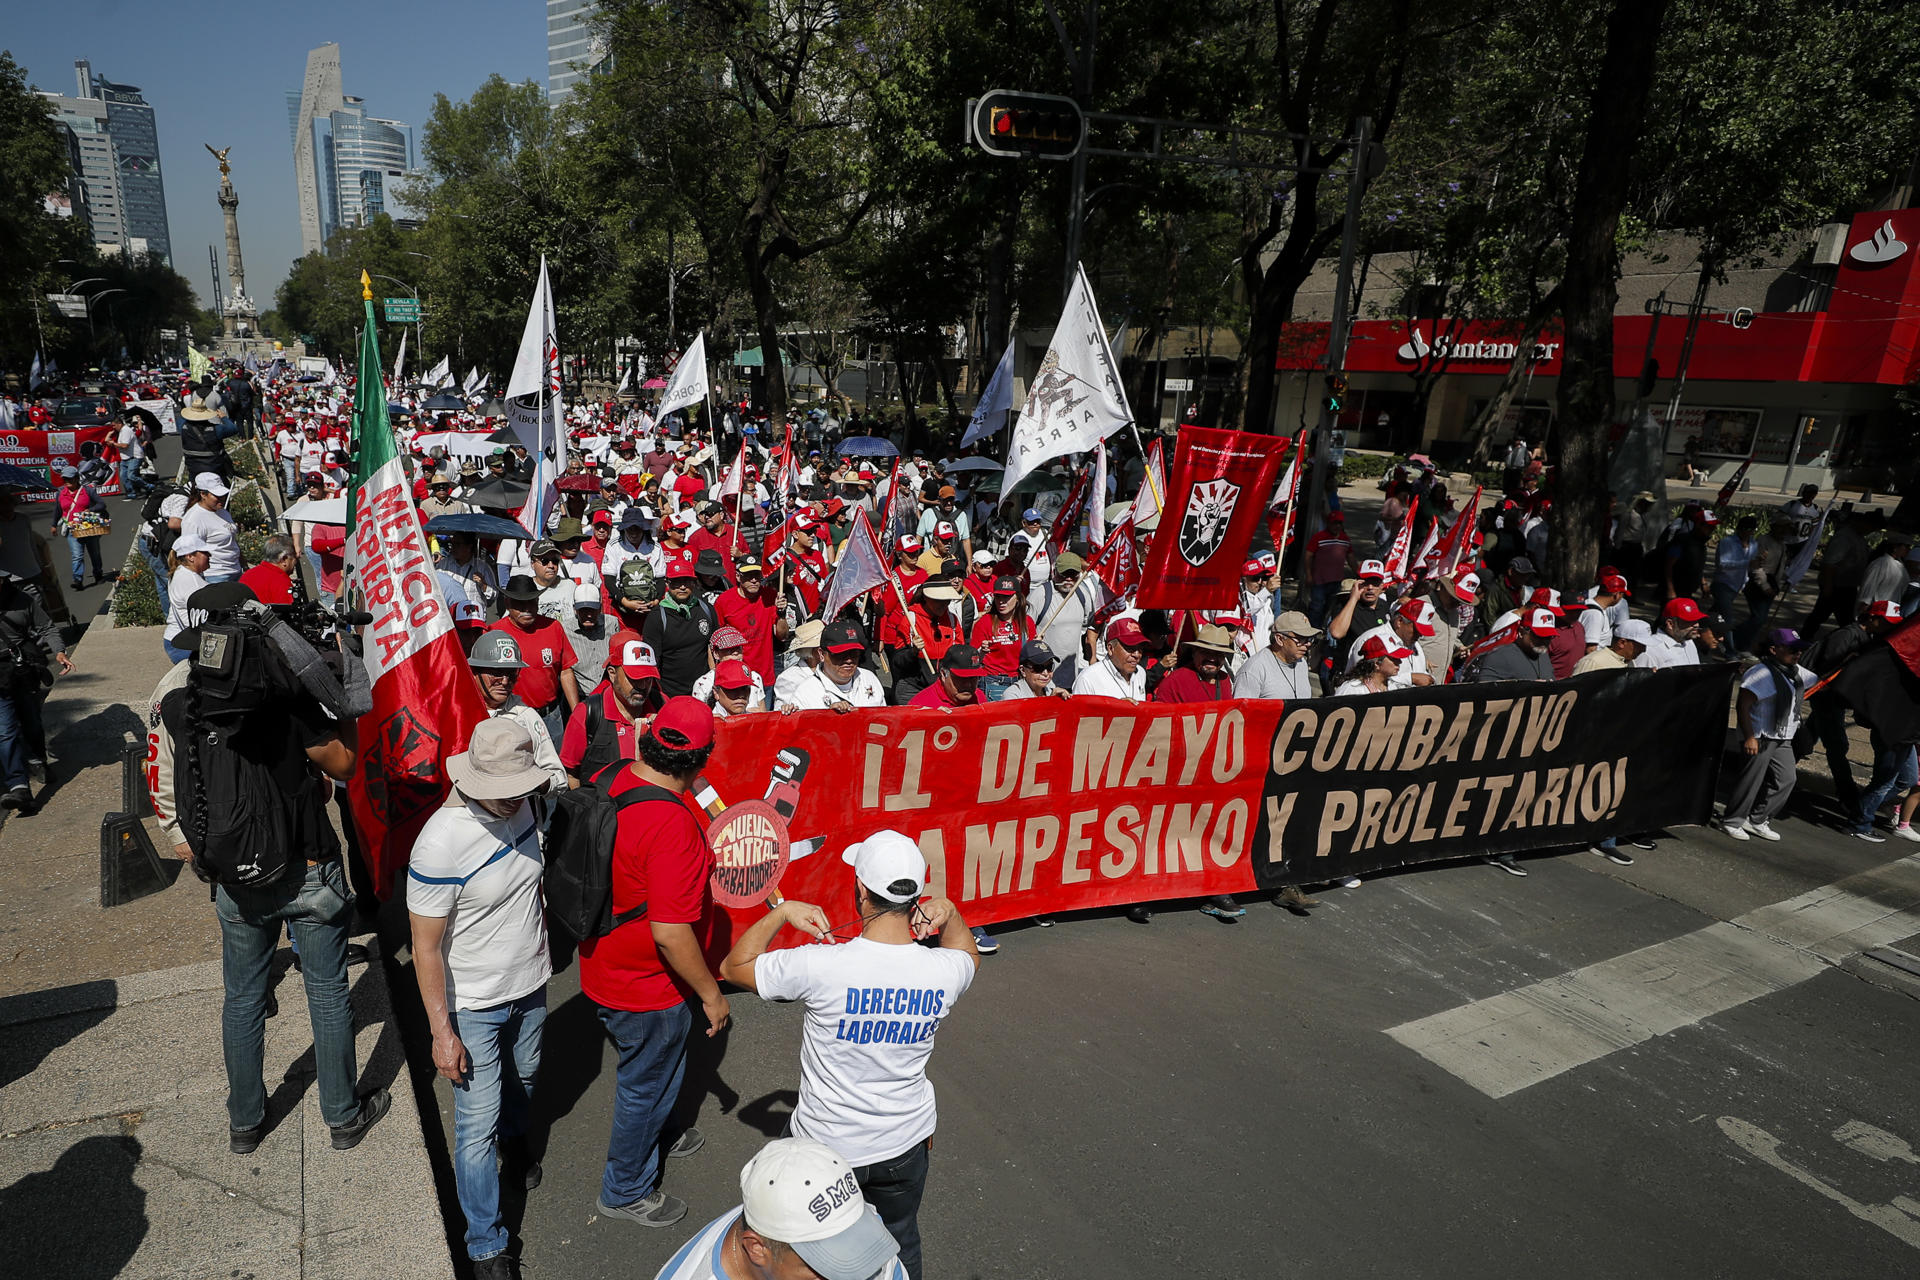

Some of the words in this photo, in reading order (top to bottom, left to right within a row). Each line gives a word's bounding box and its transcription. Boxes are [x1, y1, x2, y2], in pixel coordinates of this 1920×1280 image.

[115, 94, 141, 102] BBVA
[1432, 335, 1559, 360] Sntaner
[372, 483, 440, 628] MEXICO
[977, 718, 1056, 803] DE
[1071, 709, 1244, 792] MAYO
[1272, 690, 1578, 776] COMBATIVO
[713, 814, 778, 849] NUEVA
[917, 798, 1248, 902] AMPESINO
[1266, 792, 1298, 863] Y
[1316, 757, 1628, 857] PROLETARIO!
[714, 860, 778, 897] TRABAJADORES
[845, 988, 944, 1016] DERECHOS
